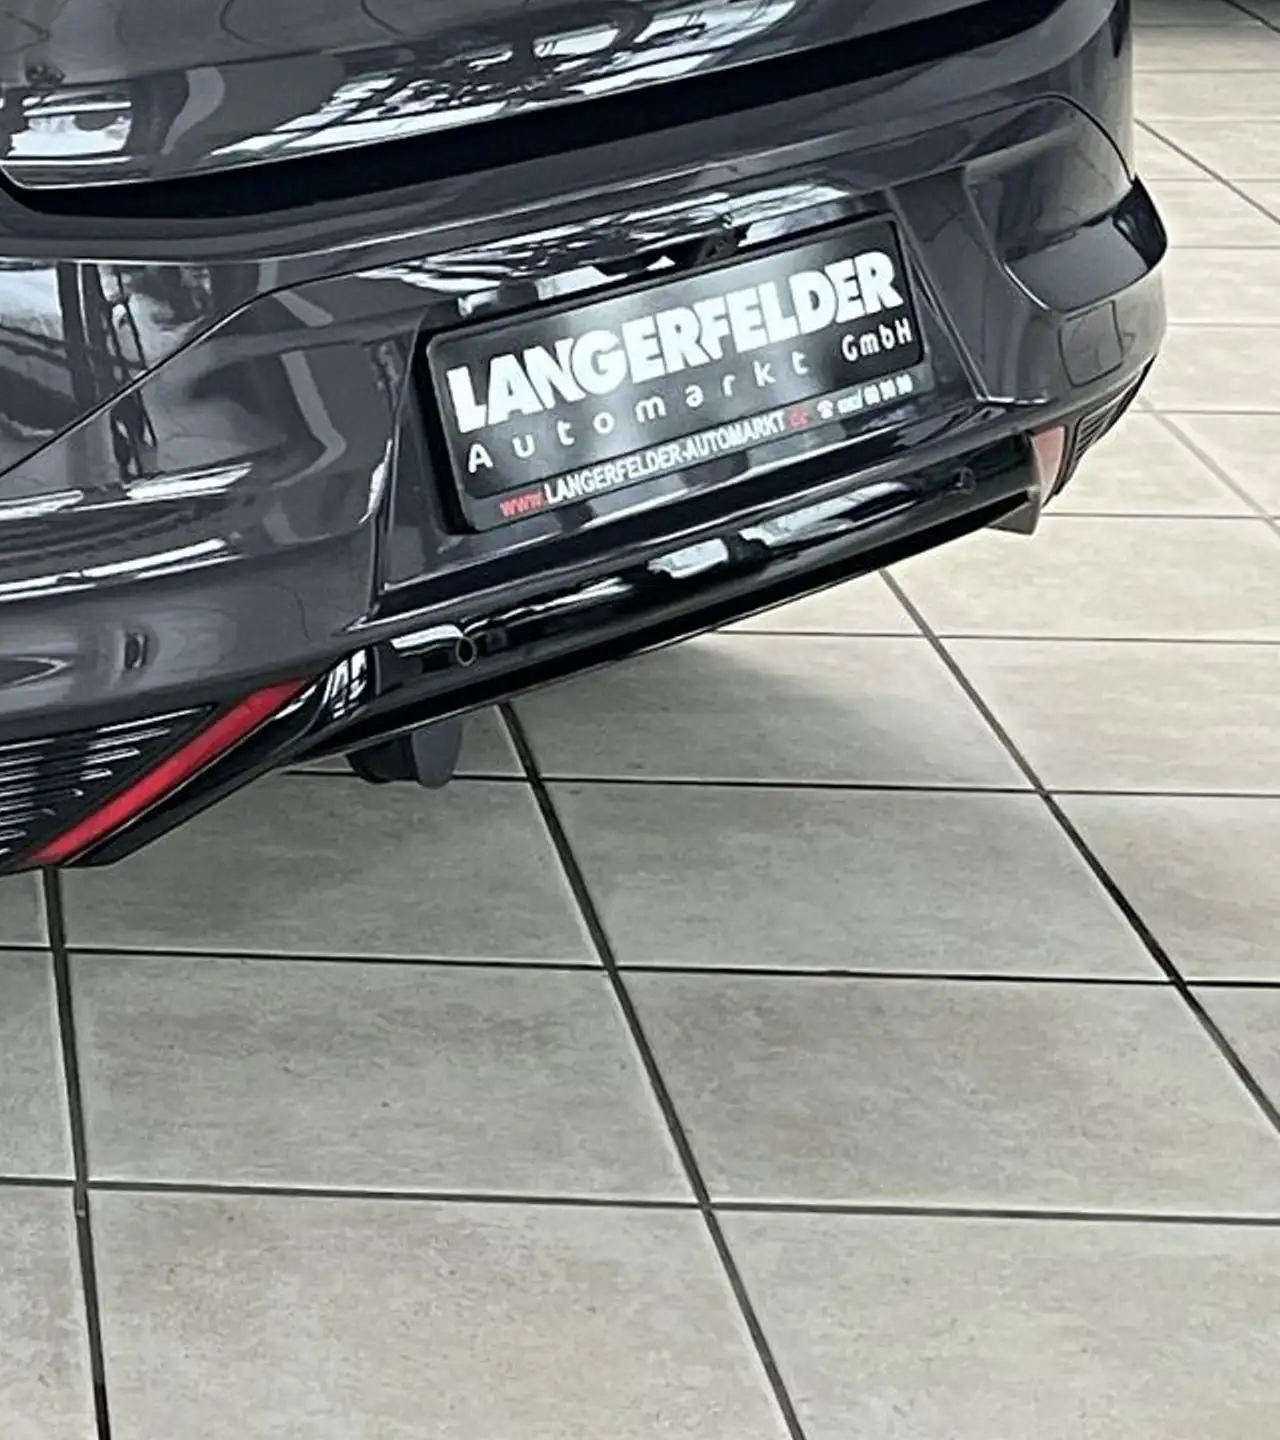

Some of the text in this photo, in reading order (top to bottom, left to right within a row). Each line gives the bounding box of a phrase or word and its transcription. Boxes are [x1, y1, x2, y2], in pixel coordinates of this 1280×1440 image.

[446, 251, 903, 434] LANGERFELDER
[467, 350, 810, 474] Automarkt
[841, 317, 912, 362] GmbH
